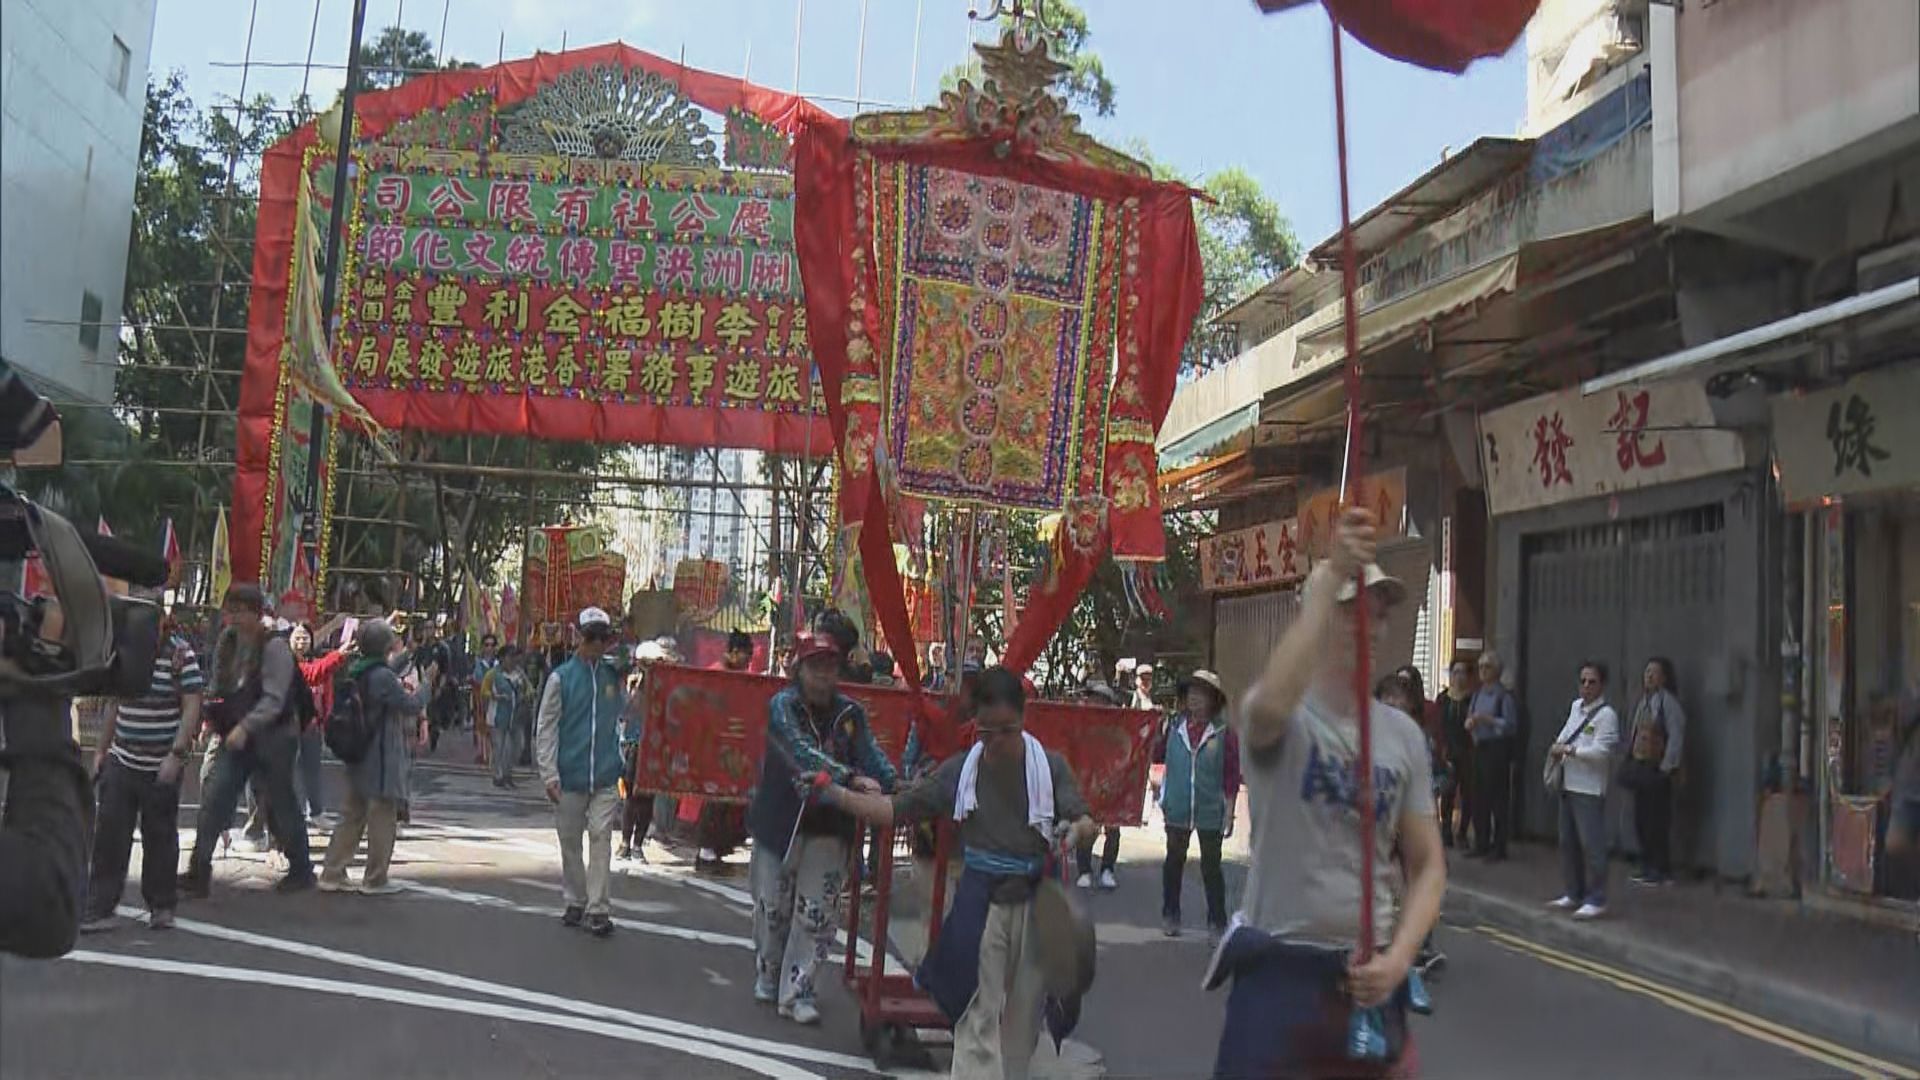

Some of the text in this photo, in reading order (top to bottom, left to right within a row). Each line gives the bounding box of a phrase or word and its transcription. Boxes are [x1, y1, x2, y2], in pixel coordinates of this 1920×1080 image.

[366, 224, 792, 294] 脷洲洪聖傳統文化節
[425, 282, 589, 334] 金利豐
[604, 295, 760, 346] 李樹福
[353, 335, 582, 387] 香港旅遊發展局
[603, 349, 802, 403] 旅遊事務署
